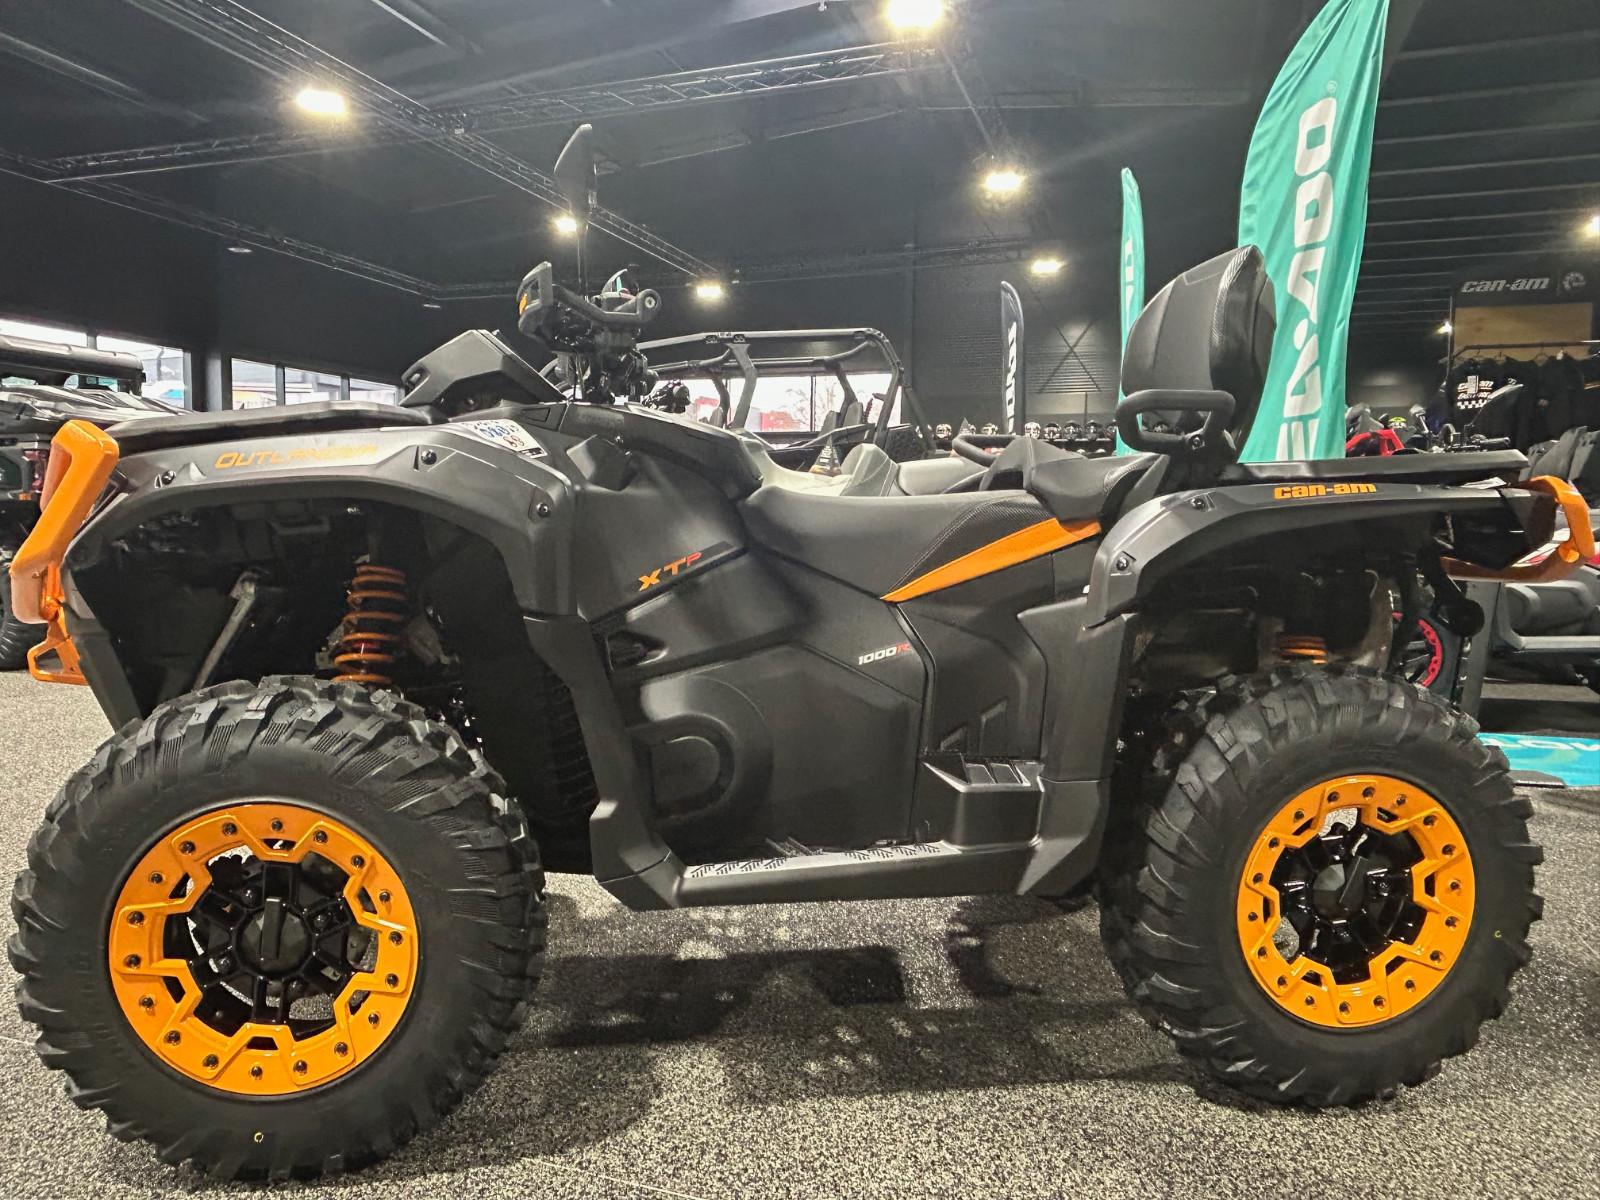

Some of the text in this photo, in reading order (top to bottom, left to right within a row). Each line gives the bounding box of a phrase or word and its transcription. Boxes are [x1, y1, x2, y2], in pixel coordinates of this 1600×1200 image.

[1461, 277, 1550, 293] can-am
[1273, 483, 1377, 500] can-am
[638, 551, 702, 592] XTP
[858, 642, 912, 666] 1000R
